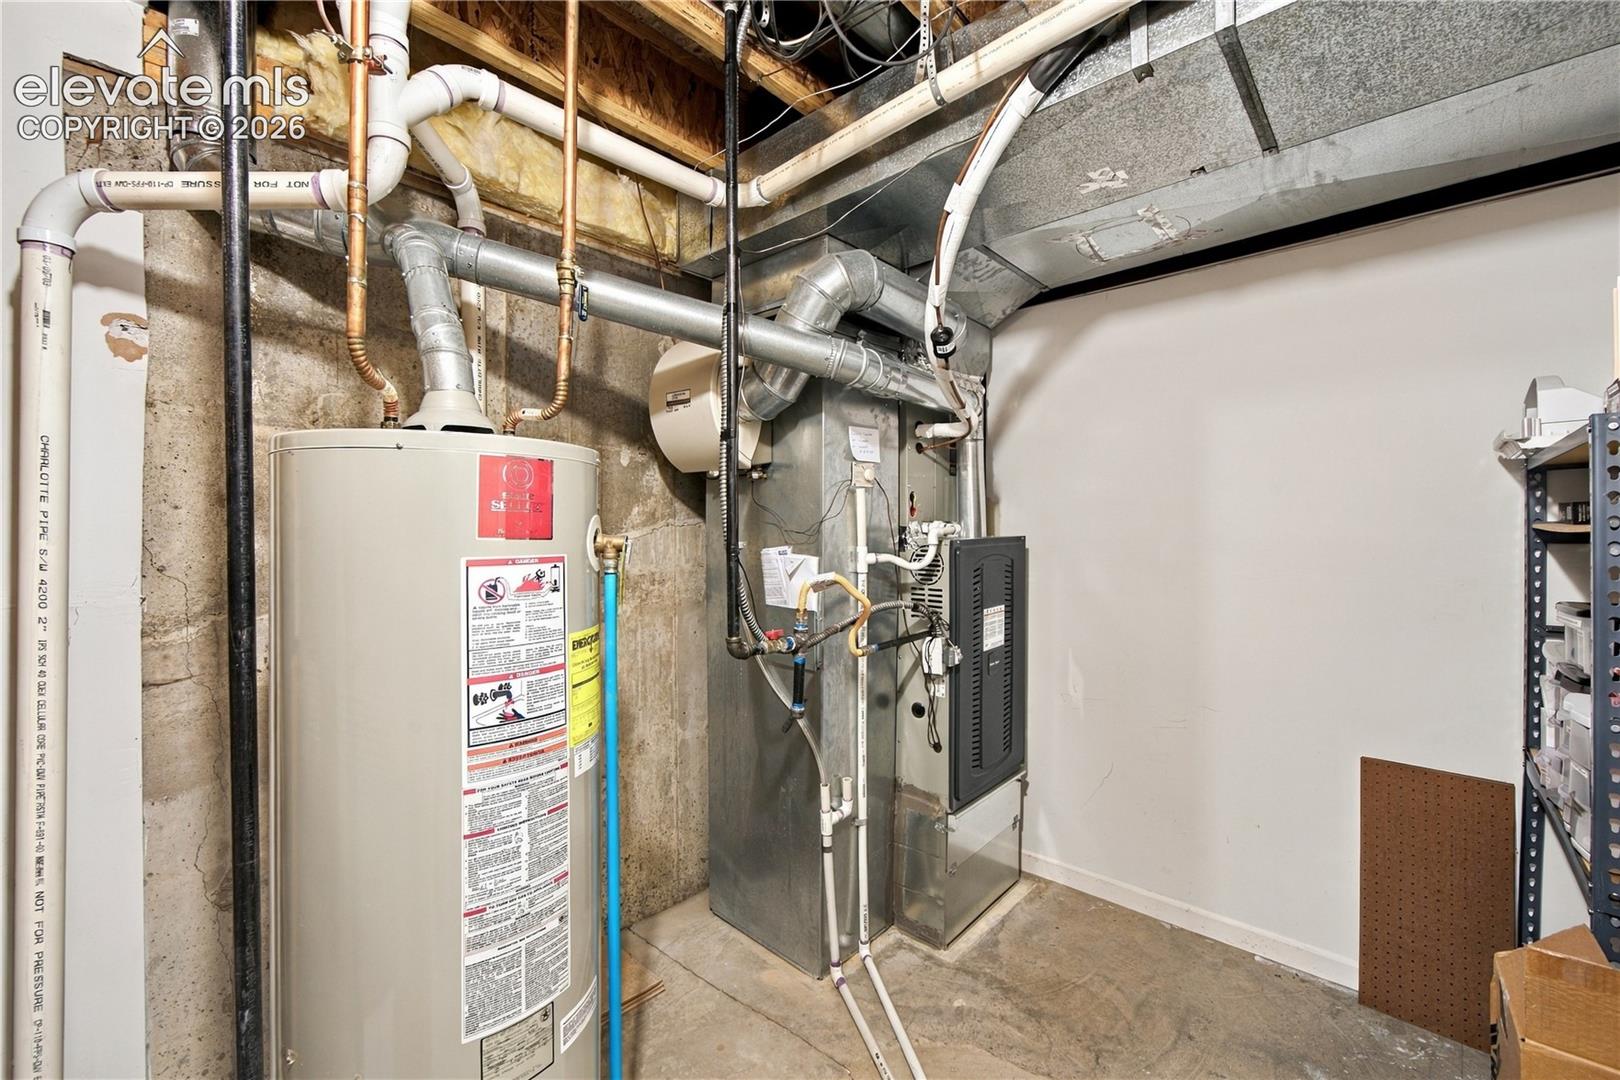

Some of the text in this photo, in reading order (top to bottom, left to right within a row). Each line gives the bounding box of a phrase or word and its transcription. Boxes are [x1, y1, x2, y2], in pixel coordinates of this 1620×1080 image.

[253, 180, 278, 188] FOR
[286, 180, 310, 188] NOT
[38, 435, 48, 504] CHARLOTTE
[38, 510, 48, 542] PIPE
[37, 548, 47, 572] S/W
[37, 578, 47, 609] 4200
[36, 669, 46, 678] 40
[34, 891, 44, 913] NOT
[34, 920, 44, 945] FOR
[33, 951, 44, 1013] PRESSURE
